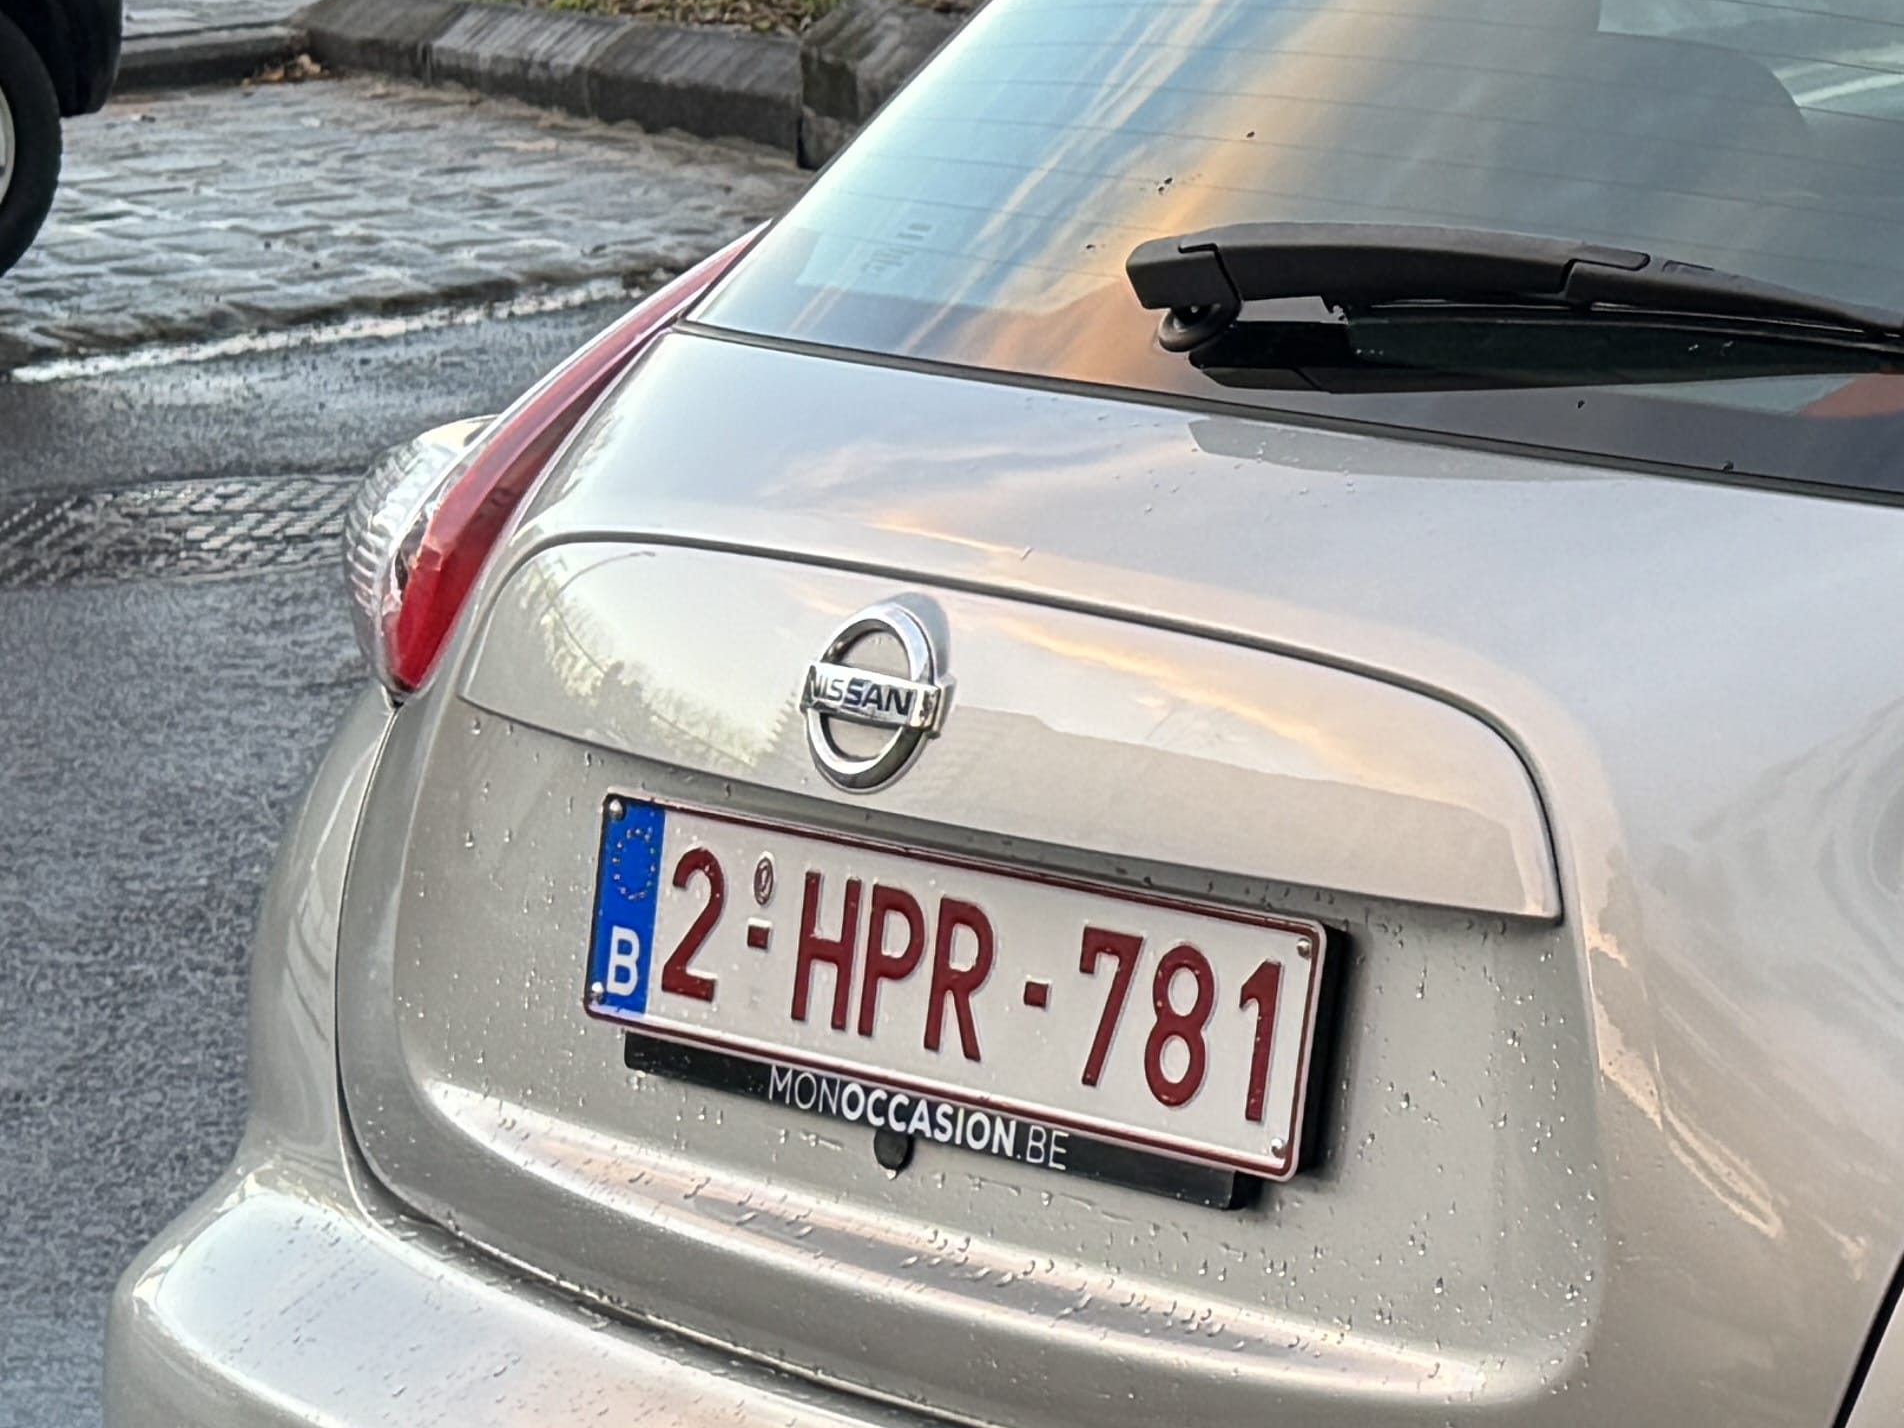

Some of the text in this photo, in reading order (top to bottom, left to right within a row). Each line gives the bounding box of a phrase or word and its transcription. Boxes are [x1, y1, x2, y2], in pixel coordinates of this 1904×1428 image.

[801, 665, 915, 716] NISSAN
[605, 925, 641, 999] B
[660, 846, 1283, 1124] 2-HPR-781
[768, 1064, 1070, 1171] MONOCCASION.BE
